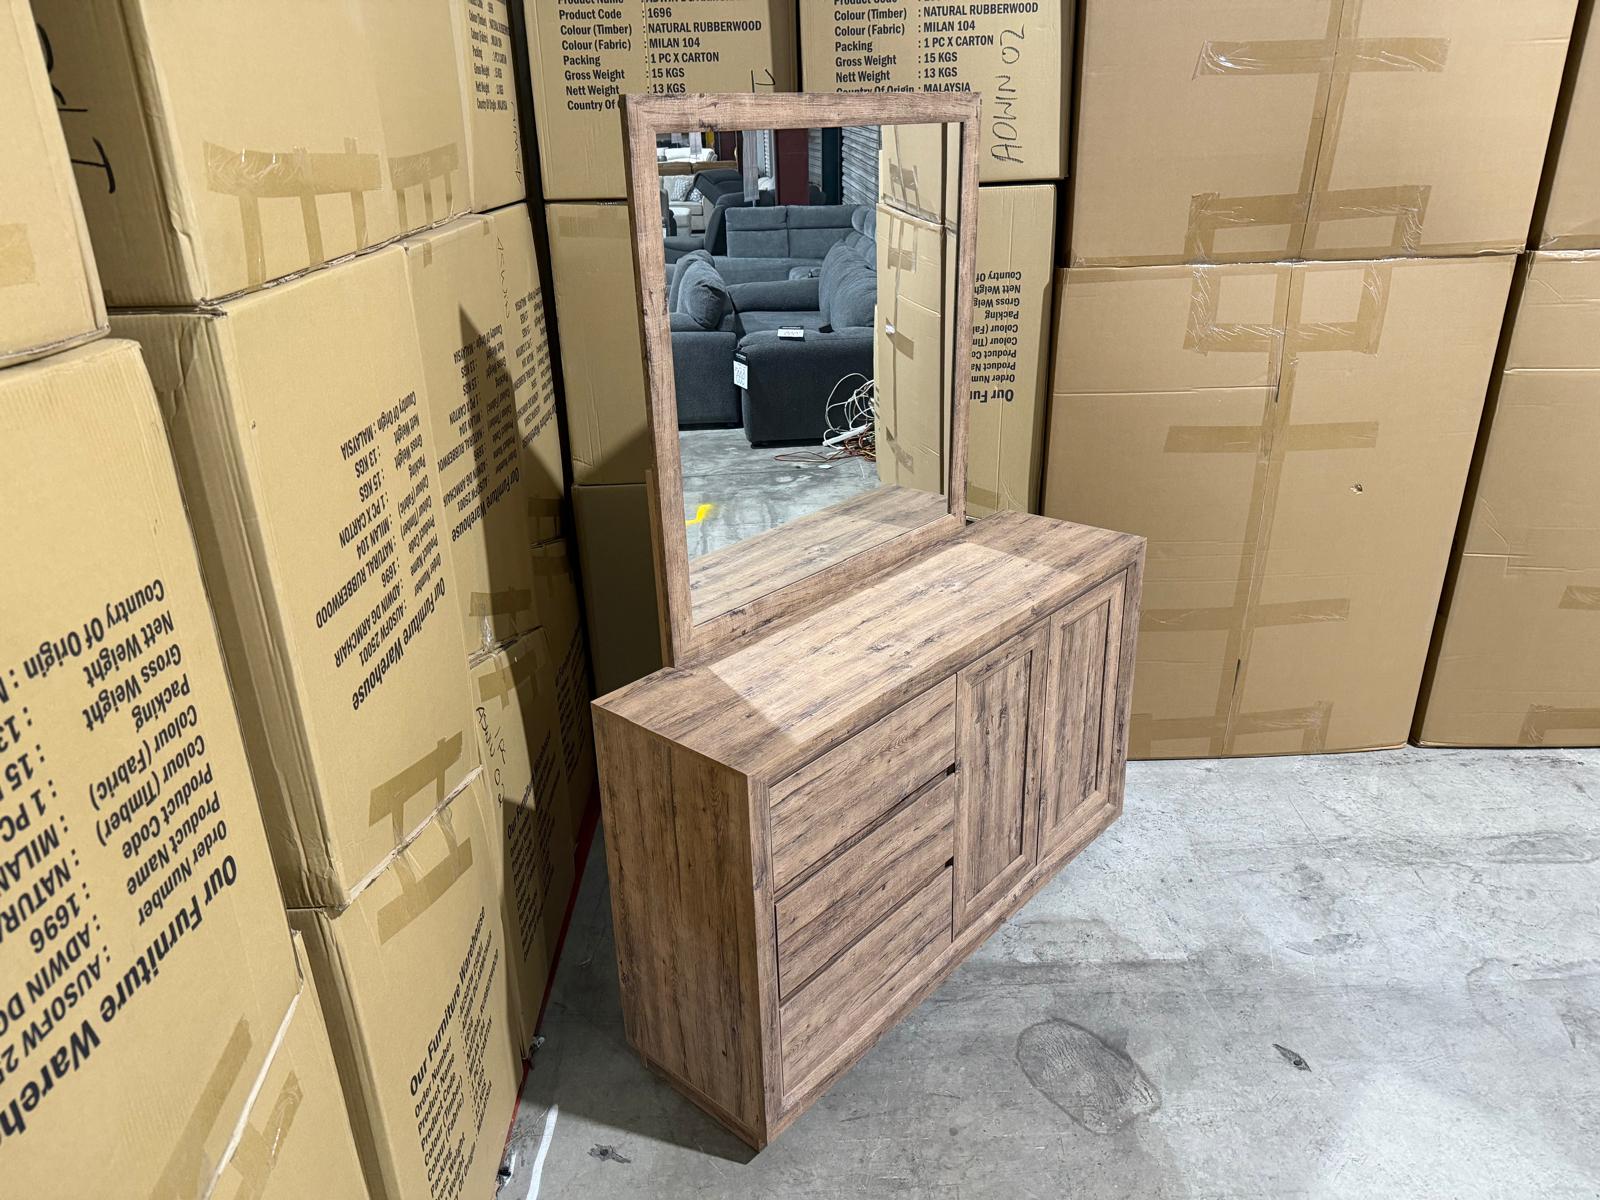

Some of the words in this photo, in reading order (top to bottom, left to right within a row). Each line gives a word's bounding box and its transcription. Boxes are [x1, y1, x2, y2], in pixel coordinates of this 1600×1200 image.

[559, 10, 596, 20] Product
[598, 9, 622, 19] Code
[648, 7, 672, 18] 1696
[561, 24, 591, 35] Colour
[593, 24, 632, 36] (Timber)
[648, 23, 691, 33] NATURAL
[694, 21, 762, 32] RUBBERWOOD
[834, 10, 865, 21] Colour
[868, 8, 907, 21] (Timber)
[923, 5, 967, 17] NATURAL
[970, 2, 1038, 15] RUBBERWOOD
[835, 26, 865, 36] Colour
[868, 23, 905, 37] (Fabric)
[924, 21, 955, 32] MILAN
[958, 21, 975, 31] 104
[562, 40, 592, 50] Colour
[593, 39, 631, 51] (Fabric)
[650, 38, 680, 48] MILAN
[682, 37, 700, 48] 104
[563, 55, 600, 67] Packing
[650, 54, 656, 64] 1
[659, 53, 671, 64] PC
[673, 53, 680, 63] X
[682, 52, 720, 63] CARTON
[835, 41, 873, 52] Packing
[924, 38, 929, 48] 1
[932, 37, 945, 48] PC
[947, 36, 954, 47] X
[956, 35, 994, 46] CARTON
[836, 56, 862, 67] Gross
[864, 55, 897, 67] Weight
[924, 53, 936, 63] 15
[938, 52, 958, 63] KGS
[564, 70, 591, 80] Gross
[593, 69, 625, 82] Weight
[652, 68, 663, 78] 15
[666, 68, 685, 78] KGS
[566, 86, 585, 95] Nett
[587, 85, 619, 96] Weight
[653, 84, 664, 94] 13
[666, 83, 686, 93] KGS
[836, 72, 856, 83] Nett
[857, 70, 890, 83] Weight
[924, 69, 936, 79] 13
[938, 67, 958, 78] KGS
[924, 82, 971, 92] MALAYSIA
[567, 101, 603, 112] Country
[605, 100, 616, 110] Of
[991, 389, 1014, 402] Our
[106, 579, 164, 627] Country
[83, 617, 104, 649] Of
[140, 610, 174, 648] Nett
[23, 631, 81, 678] Origin
[83, 634, 142, 687] Weight
[140, 644, 181, 683] Gross
[82, 675, 141, 730] Weight
[131, 674, 190, 732] Packing
[154, 705, 197, 752] Colour
[4, 753, 33, 791] 15
[89, 740, 151, 810] (Fabric)
[163, 735, 204, 783] Colour
[96, 772, 160, 846] (Timber)
[160, 762, 212, 824] Product
[122, 815, 160, 858] Code
[169, 791, 220, 853] Product
[192, 820, 226, 865] Order
[127, 844, 169, 894] Name
[138, 857, 192, 925] Number
[204, 855, 236, 905] Our
[0, 859, 70, 943] NATUR
[30, 893, 79, 953] 1696
[26, 923, 90, 1002] ADWIN
[100, 896, 201, 1021] Furniture
[22, 955, 100, 1056] AUSOFW
[410, 1057, 427, 1096] Our
[427, 983, 460, 1062] Furniture
